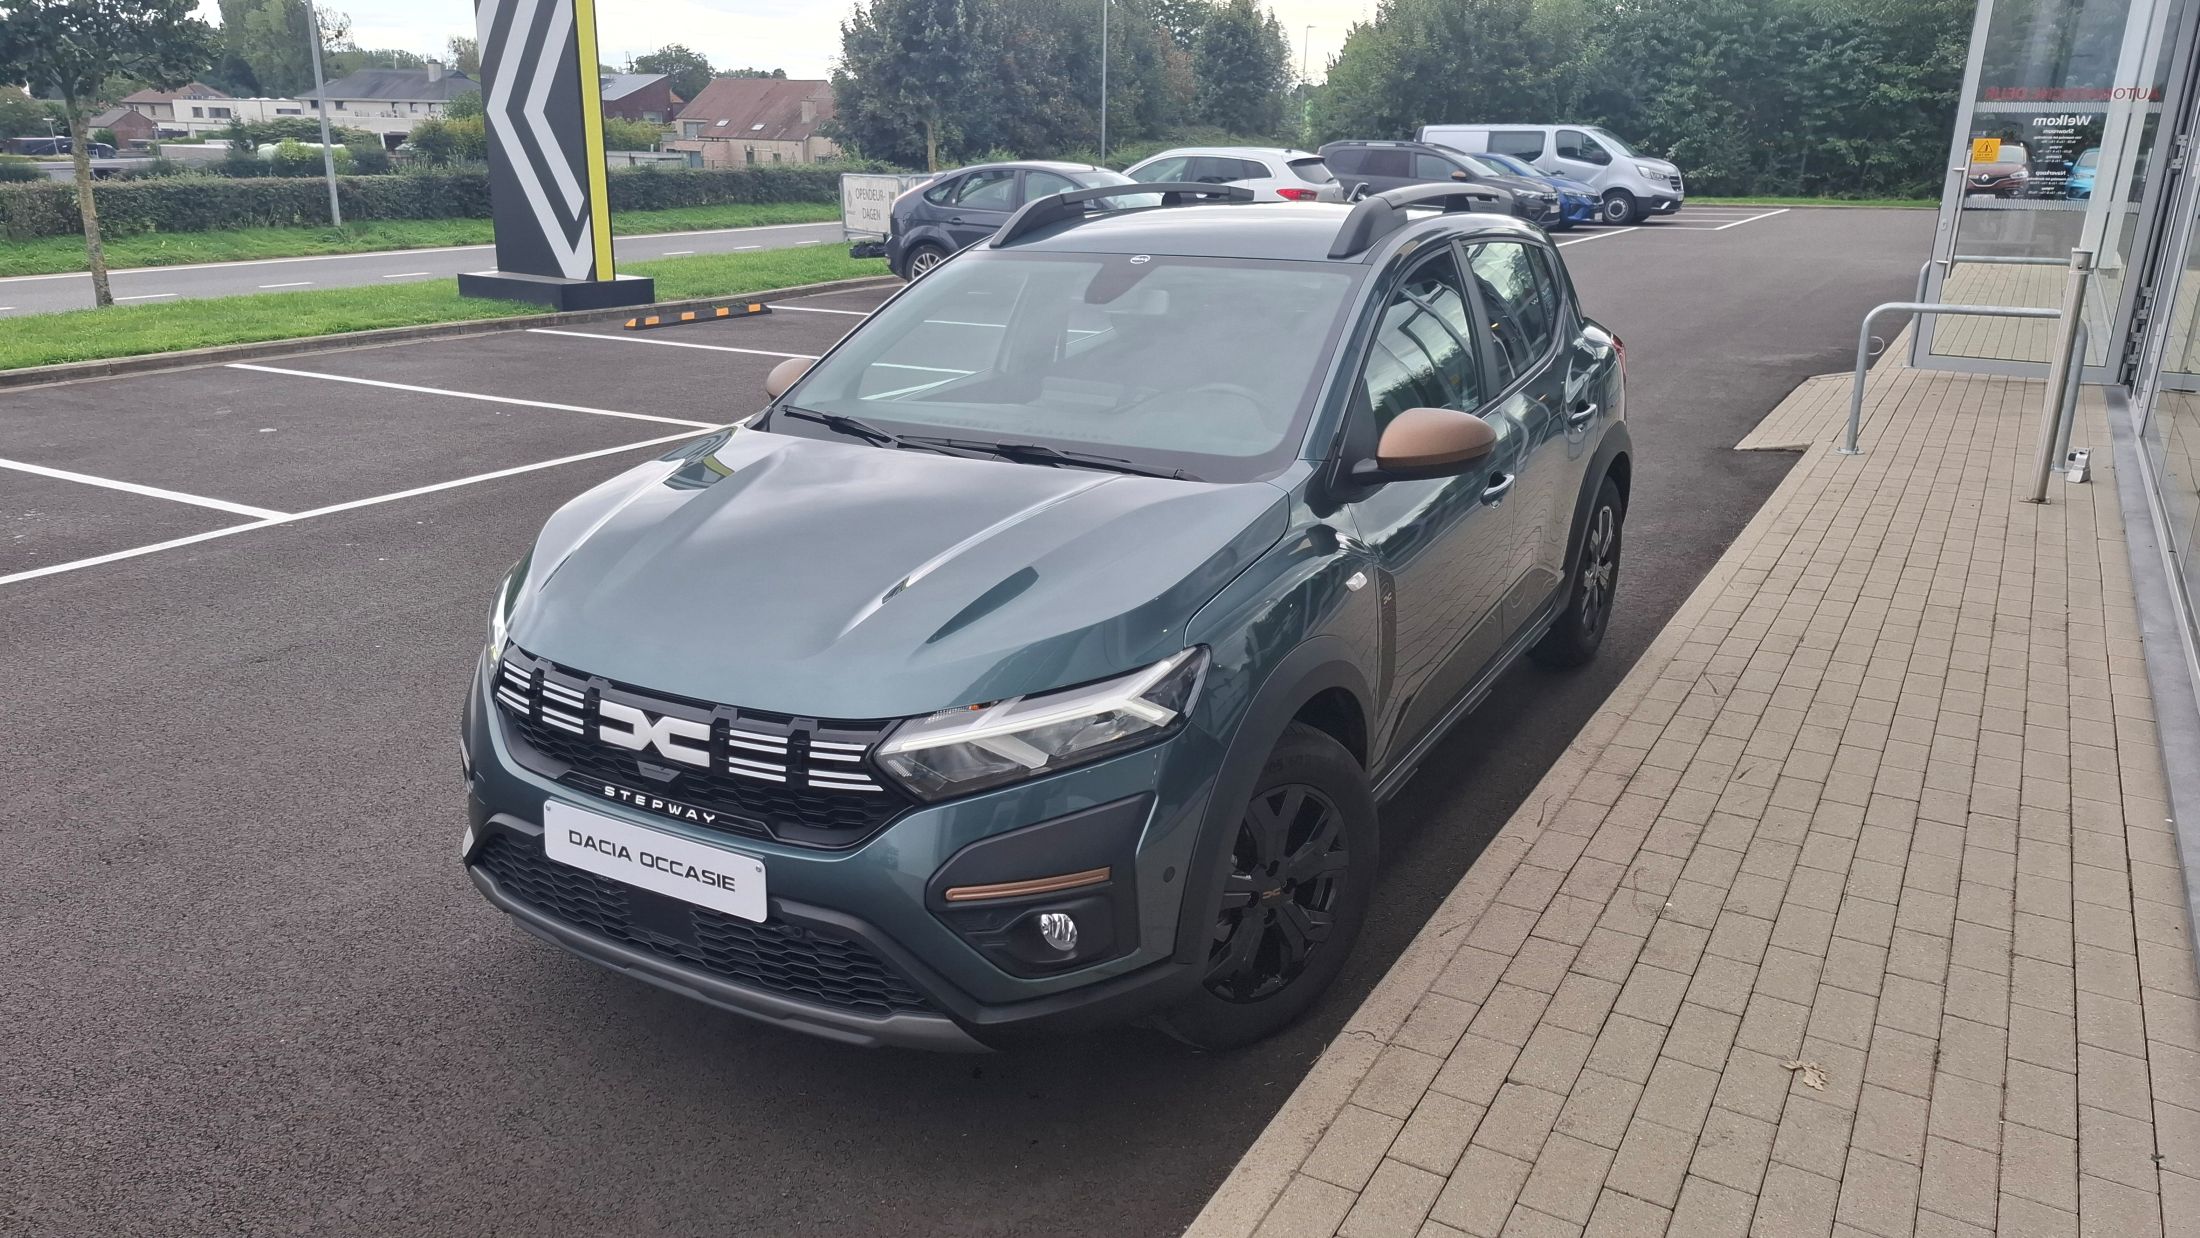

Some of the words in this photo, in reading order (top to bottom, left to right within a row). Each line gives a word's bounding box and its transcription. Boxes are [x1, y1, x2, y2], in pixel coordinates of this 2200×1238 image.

[862, 208, 880, 220] DAGEN
[604, 786, 716, 823] STEPWAY
[568, 829, 632, 862] DACIA
[640, 851, 735, 892] OCCASIE
